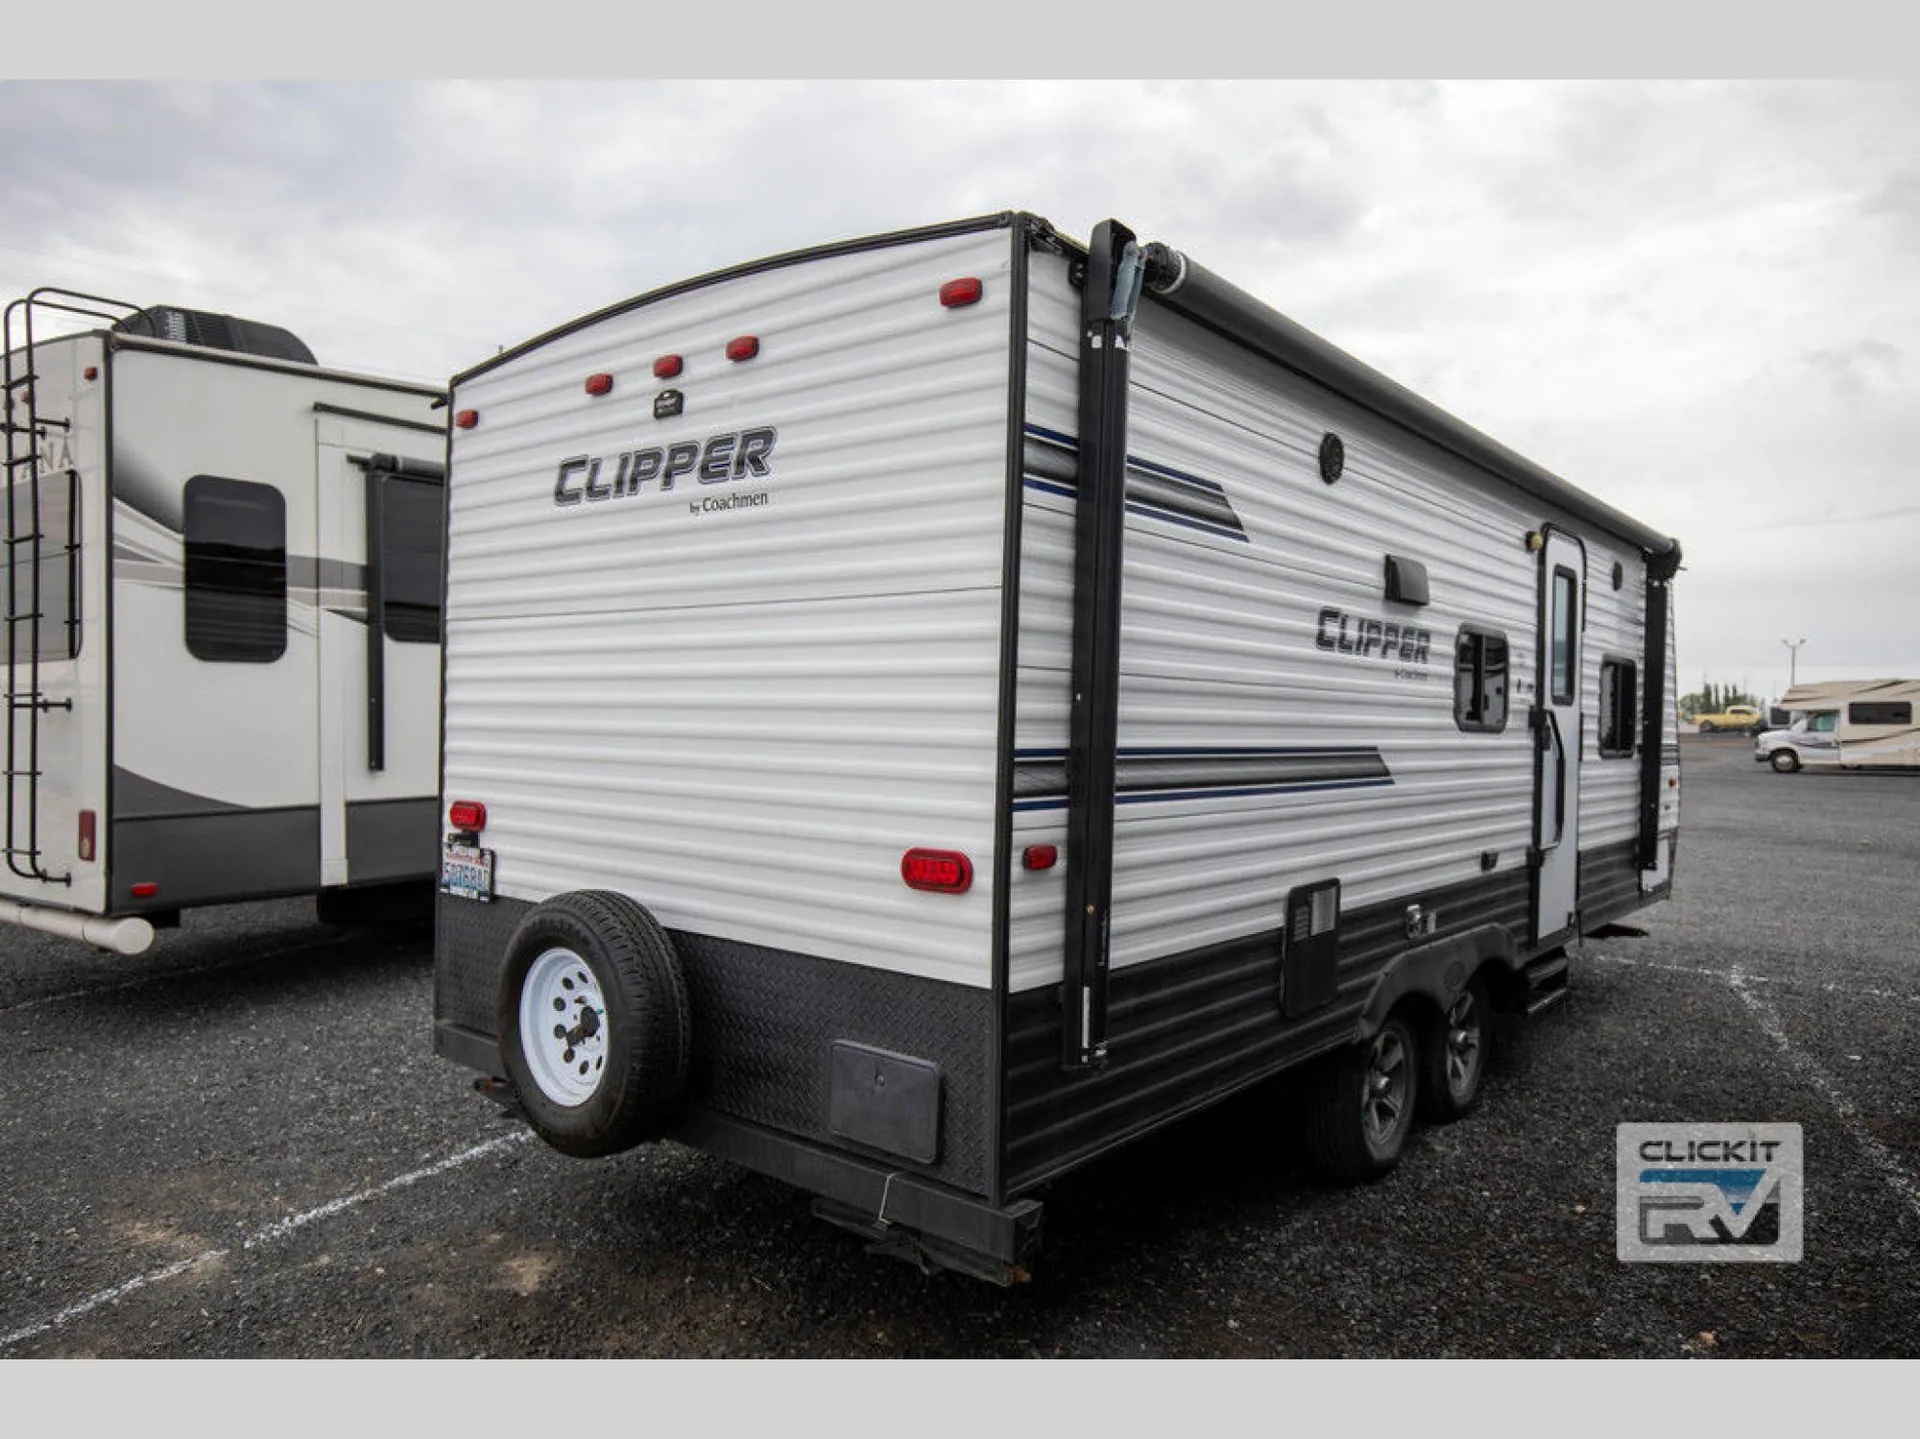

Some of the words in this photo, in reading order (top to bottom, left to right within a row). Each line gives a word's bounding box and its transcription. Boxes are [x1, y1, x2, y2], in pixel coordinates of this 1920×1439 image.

[554, 425, 777, 507] CLIPPER
[689, 501, 701, 516] by
[702, 491, 768, 512] Coachmen
[1316, 606, 1430, 665] CLIPPER
